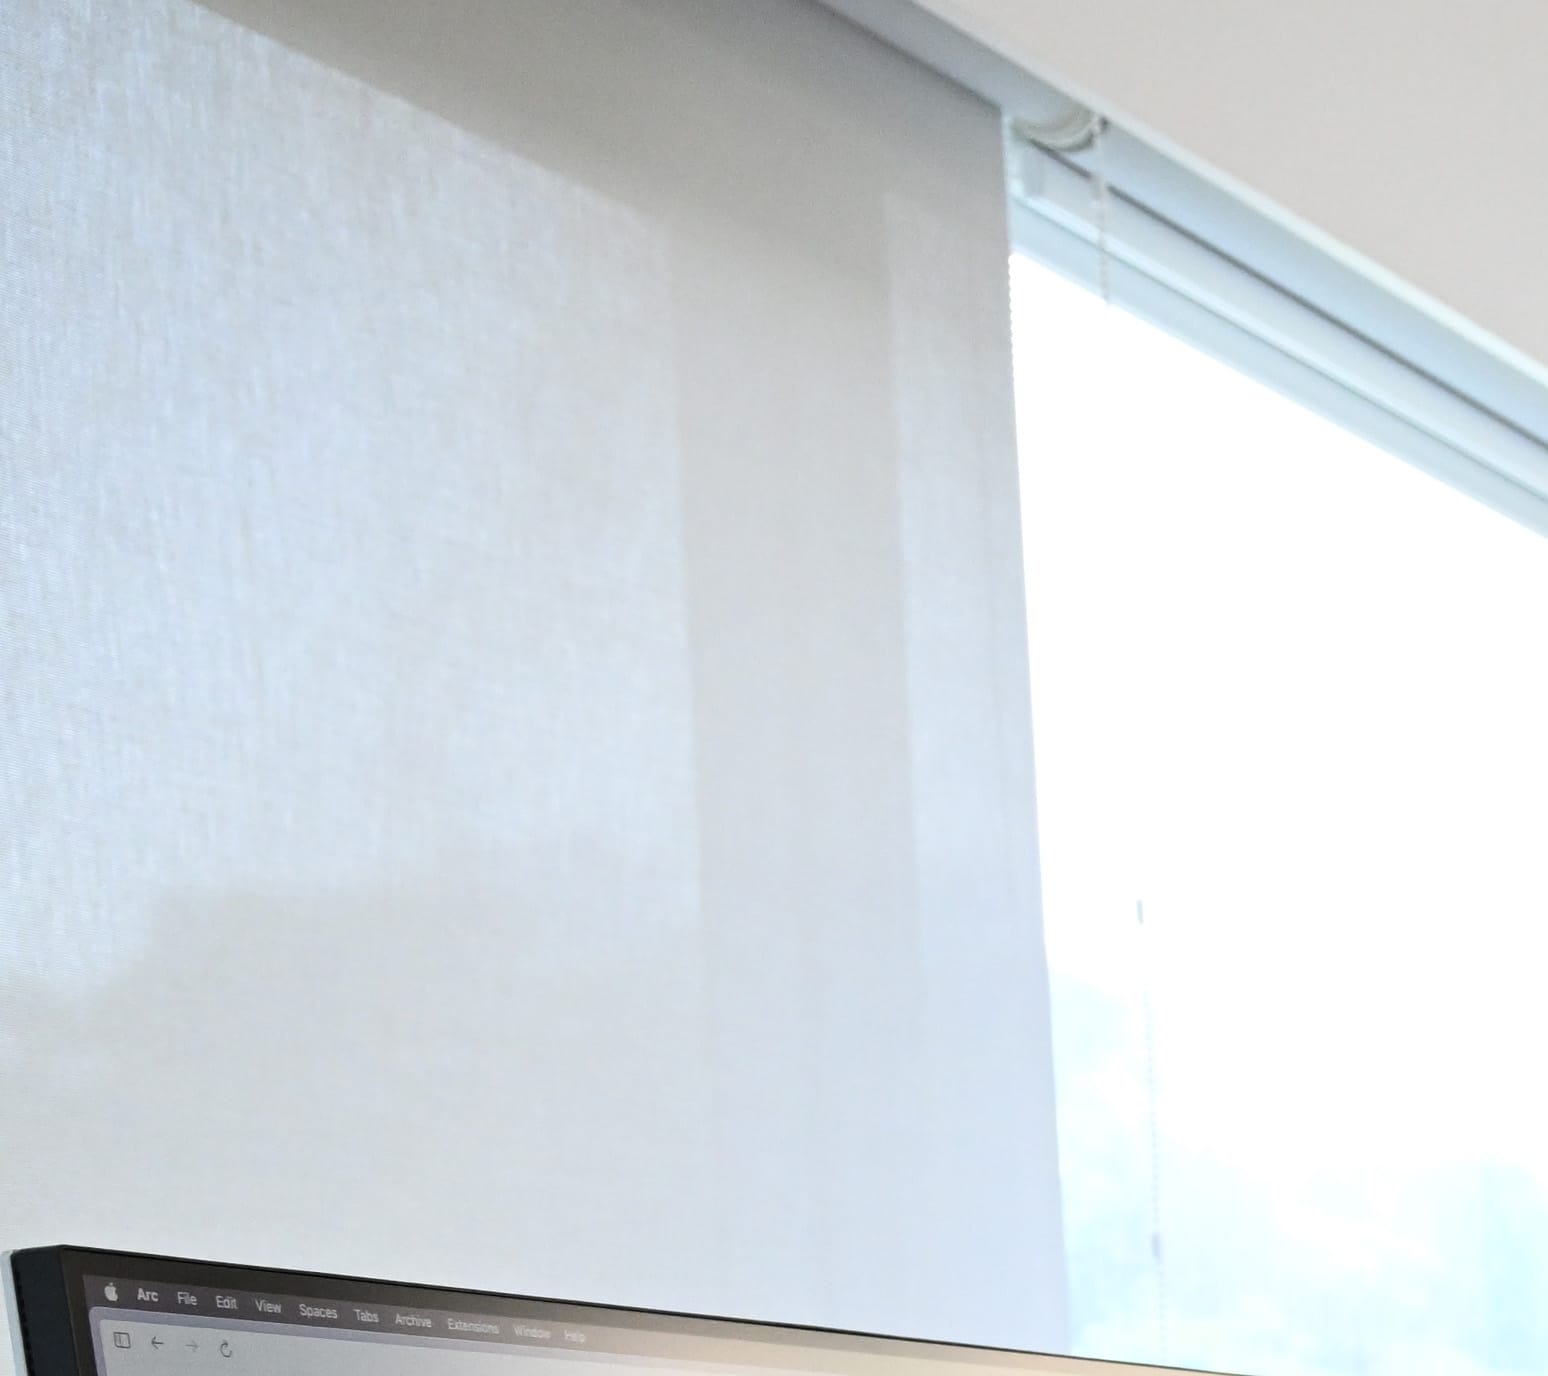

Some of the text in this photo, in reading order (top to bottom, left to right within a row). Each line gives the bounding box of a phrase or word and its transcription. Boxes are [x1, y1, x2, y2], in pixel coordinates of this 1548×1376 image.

[137, 1288, 159, 1302] Arc
[177, 1291, 198, 1306] File
[215, 1295, 238, 1309] Edit
[255, 1300, 282, 1313] View
[299, 1304, 338, 1319] Spaces
[353, 1309, 379, 1323] Tabs
[395, 1314, 432, 1328] Archive
